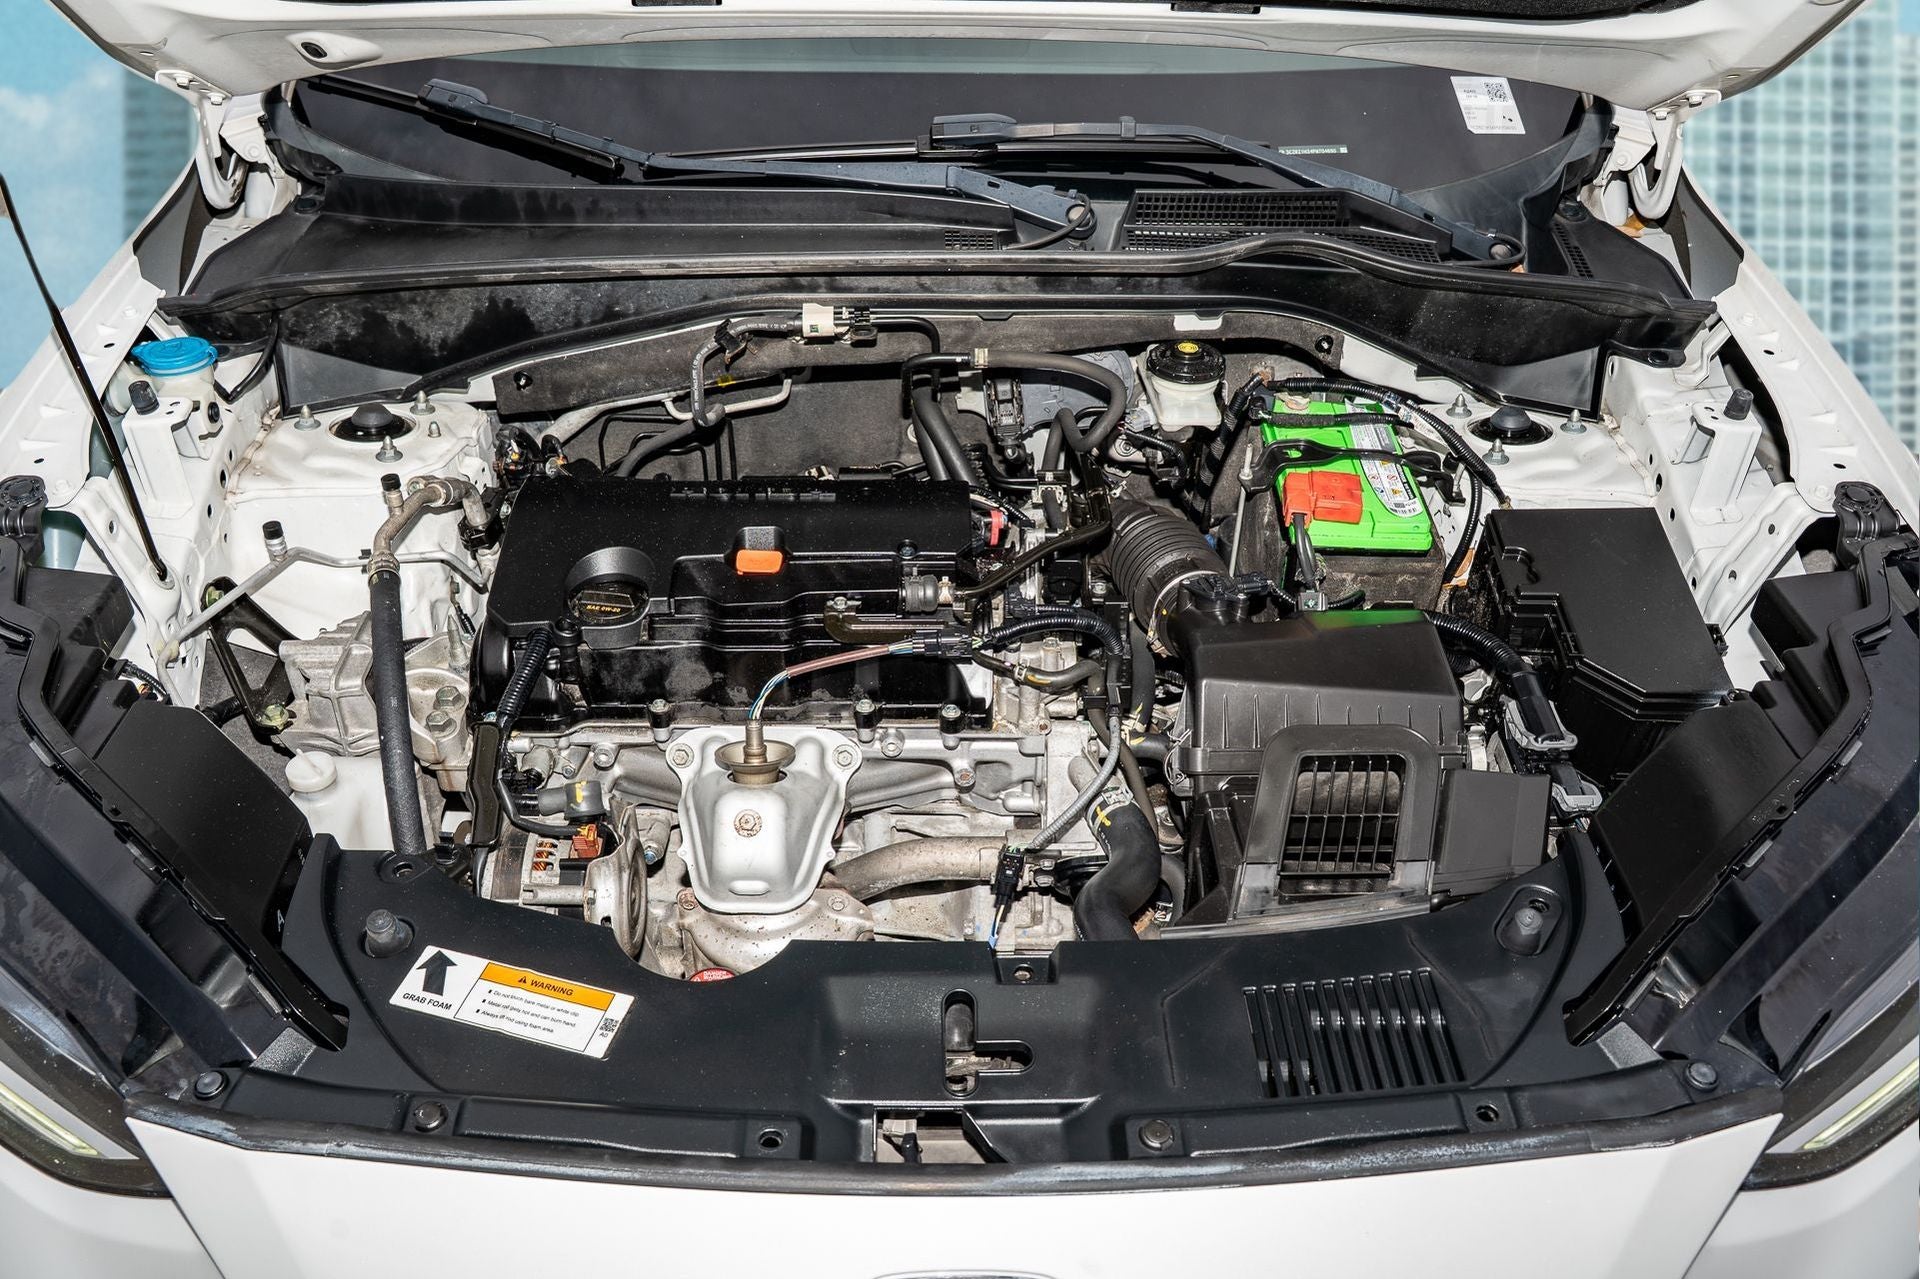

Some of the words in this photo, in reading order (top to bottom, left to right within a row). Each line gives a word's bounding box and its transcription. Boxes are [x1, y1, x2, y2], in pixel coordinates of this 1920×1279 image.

[530, 978, 574, 996] WARNING
[402, 992, 427, 1004] GRAB
[427, 999, 453, 1011] FOAM
[481, 1009, 499, 1020] Always
[515, 1018, 529, 1027] using
[529, 1021, 542, 1031] foam
